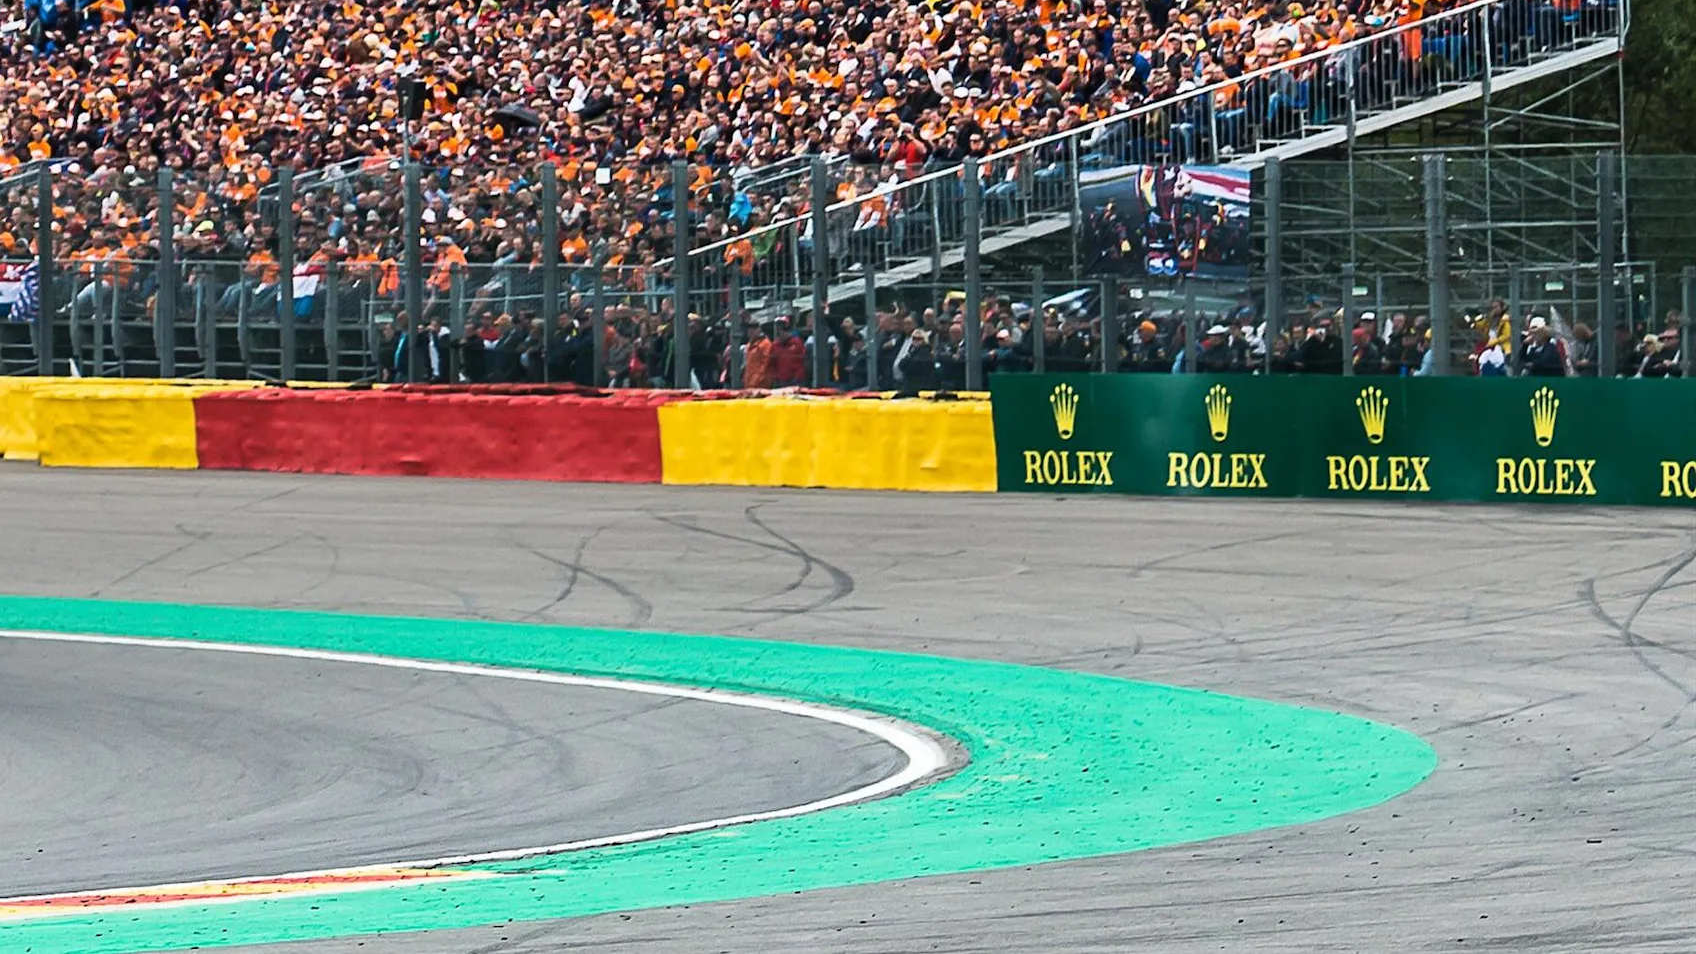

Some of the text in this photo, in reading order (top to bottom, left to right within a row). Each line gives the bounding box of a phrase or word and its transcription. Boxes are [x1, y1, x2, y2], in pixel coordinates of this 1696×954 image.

[1023, 450, 1113, 486] ROLEX
[1167, 452, 1268, 488] ROLEX
[1326, 455, 1431, 492] ROLEX
[1495, 458, 1597, 495] ROLEX
